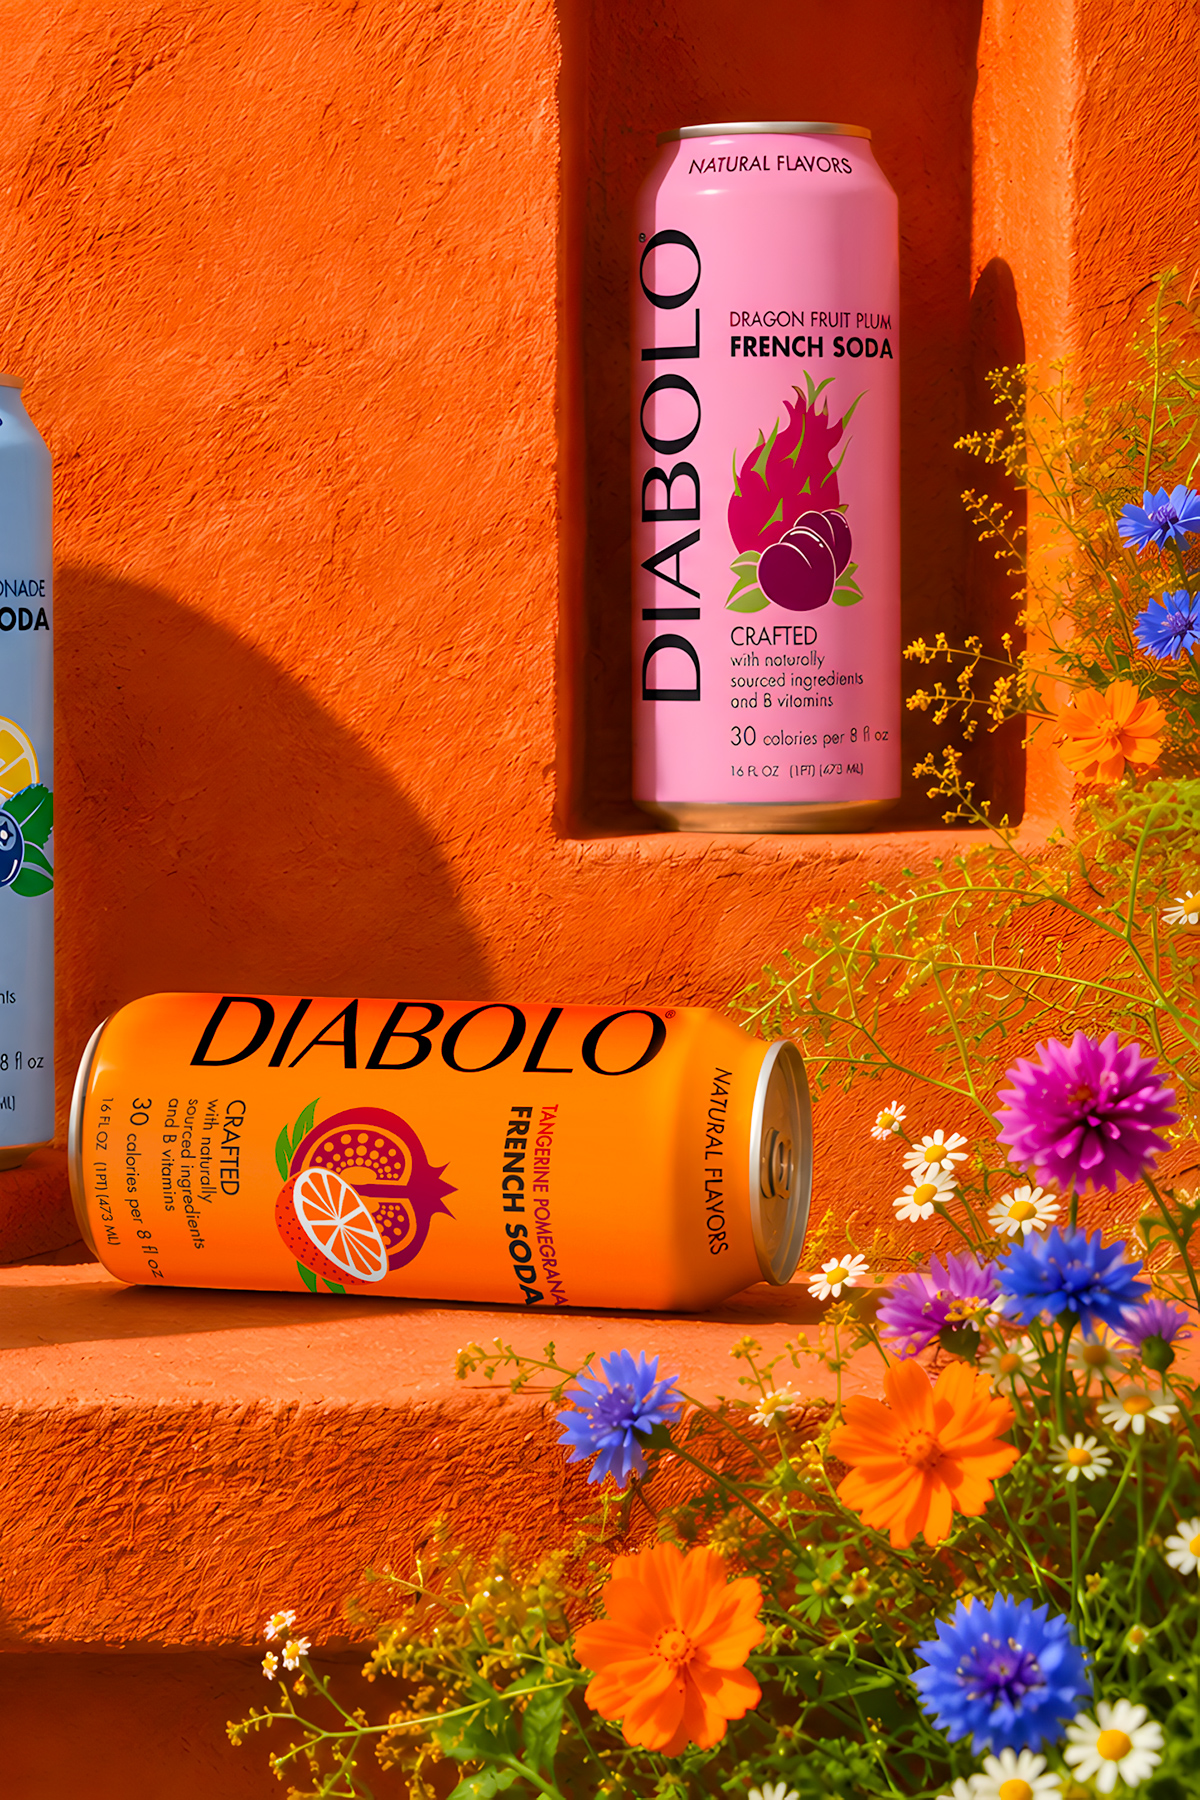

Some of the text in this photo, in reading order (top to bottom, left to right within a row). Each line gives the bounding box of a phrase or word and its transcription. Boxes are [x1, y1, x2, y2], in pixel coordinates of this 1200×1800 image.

[688, 155, 852, 174] NATURAL FLAVORS
[730, 311, 892, 330] DRAGON FRUIT PLUM
[731, 336, 893, 359] FRENCH SODA
[730, 626, 817, 646] CRAFTED
[730, 671, 864, 690] sourced ingredients
[730, 694, 757, 708] and
[764, 693, 772, 708] B
[730, 726, 756, 746] 30
[763, 730, 818, 746] calories
[823, 732, 845, 748] per
[850, 728, 857, 743] 8
[874, 730, 889, 741] oz
[731, 765, 744, 777] 16
[762, 765, 779, 777] OZ
[0, 1054, 9, 1071] 8
[15, 1052, 22, 1070] fl
[27, 1056, 44, 1069] oz
[93, 1098, 121, 1246] 16 FL OZ (1PT) (473 ML)
[160, 1098, 179, 1212] and B vitamins
[177, 1099, 205, 1249] sourced ingredients
[198, 1099, 219, 1204] with naturally
[220, 1100, 247, 1196] CRAFTED
[533, 1104, 559, 1193] TANGERINE
[704, 1067, 732, 1255] NATURAL FLAVORS
[124, 1097, 164, 1279] 30 calories per 8 fl oz
[501, 1106, 544, 1305] FRENCH SODA
